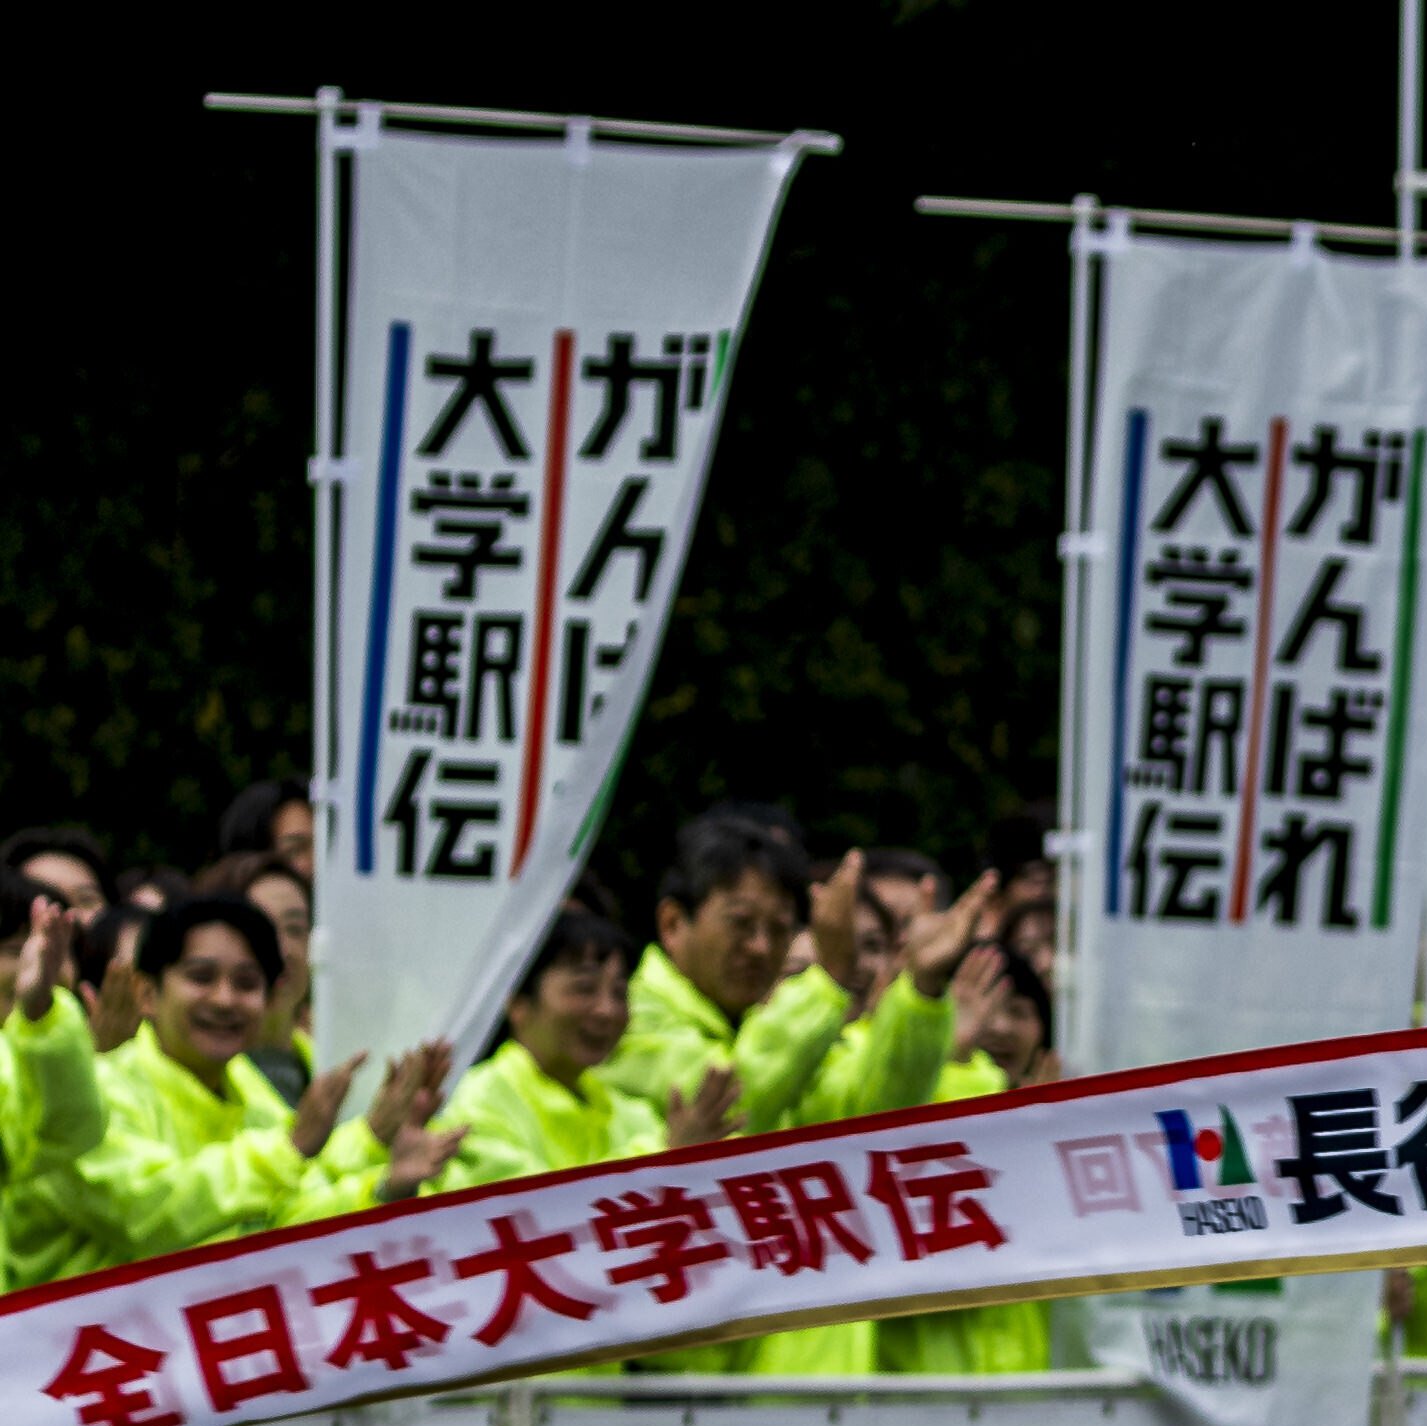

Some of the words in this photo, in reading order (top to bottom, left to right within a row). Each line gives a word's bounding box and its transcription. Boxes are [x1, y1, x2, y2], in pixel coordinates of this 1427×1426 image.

[389, 328, 536, 882] 大学駅伝
[1126, 416, 1258, 922] 大学駅伝
[1257, 423, 1407, 931] がんばれ
[1147, 1315, 1277, 1385] HASEKO
